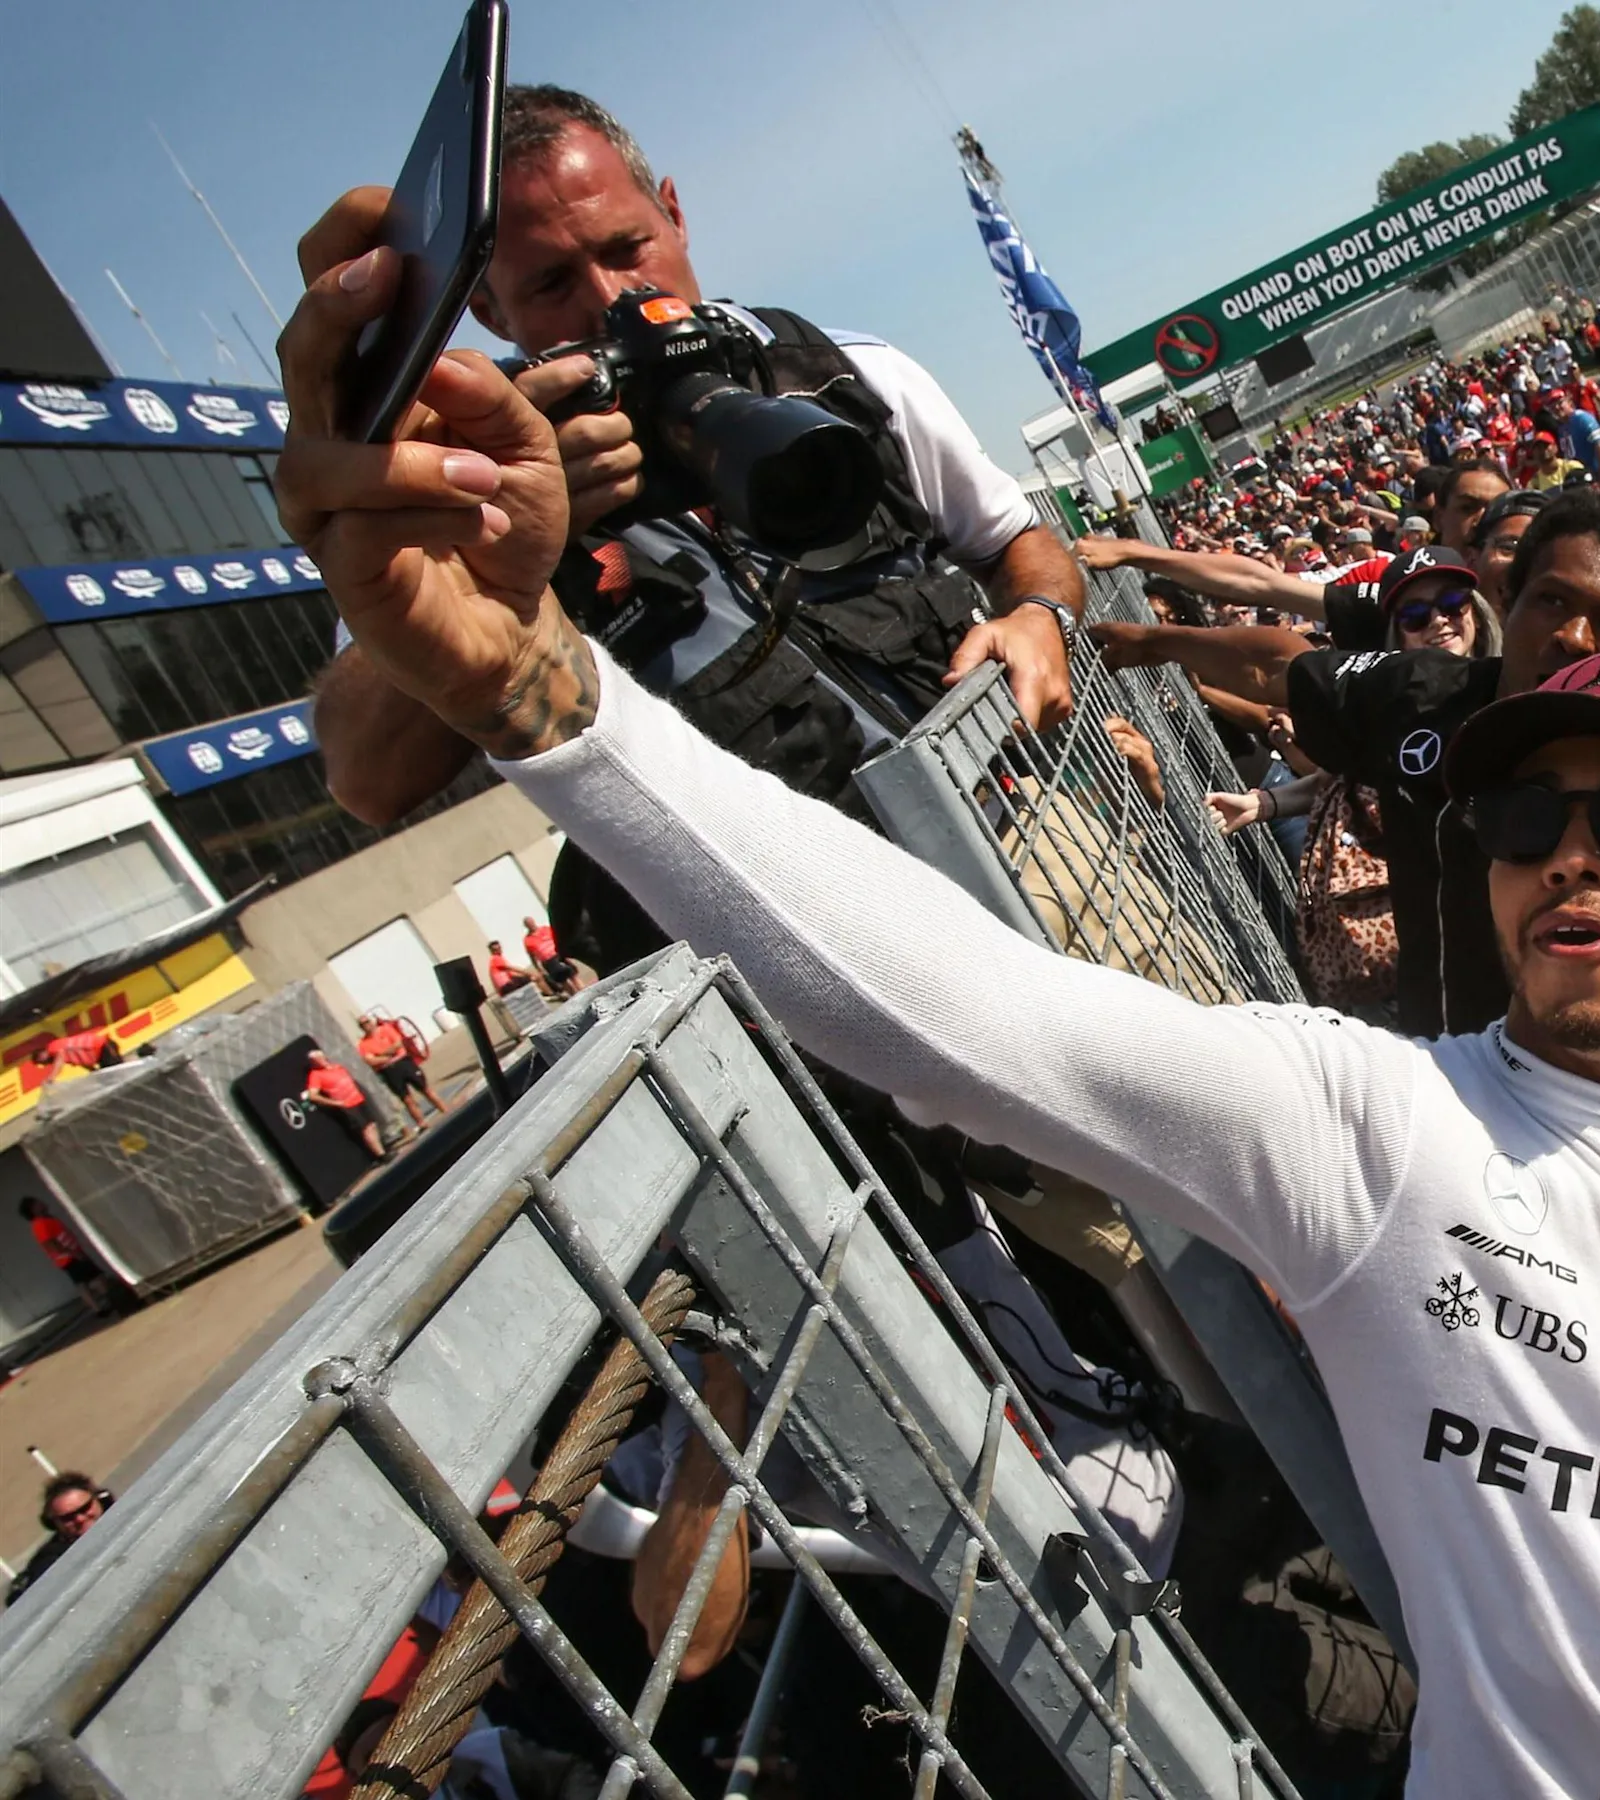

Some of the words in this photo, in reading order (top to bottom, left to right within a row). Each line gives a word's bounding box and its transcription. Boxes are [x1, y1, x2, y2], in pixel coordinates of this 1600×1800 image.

[1221, 271, 1293, 321] QUAND
[1294, 253, 1328, 284] ON
[1327, 230, 1376, 267] BOIT
[1376, 215, 1409, 243] ON
[1409, 198, 1439, 228] NE
[1439, 155, 1526, 212] CONDUIT
[1526, 137, 1563, 170] PAS
[1258, 288, 1322, 332] WHEN
[1319, 265, 1364, 303] YOU
[1363, 240, 1424, 280] DRIVE
[1423, 207, 1486, 251] NEVER
[1486, 174, 1549, 221] DRINK
[665, 337, 708, 357] Nikon
[1494, 1241, 1578, 1285] AMG
[1494, 1293, 1588, 1364] UBS
